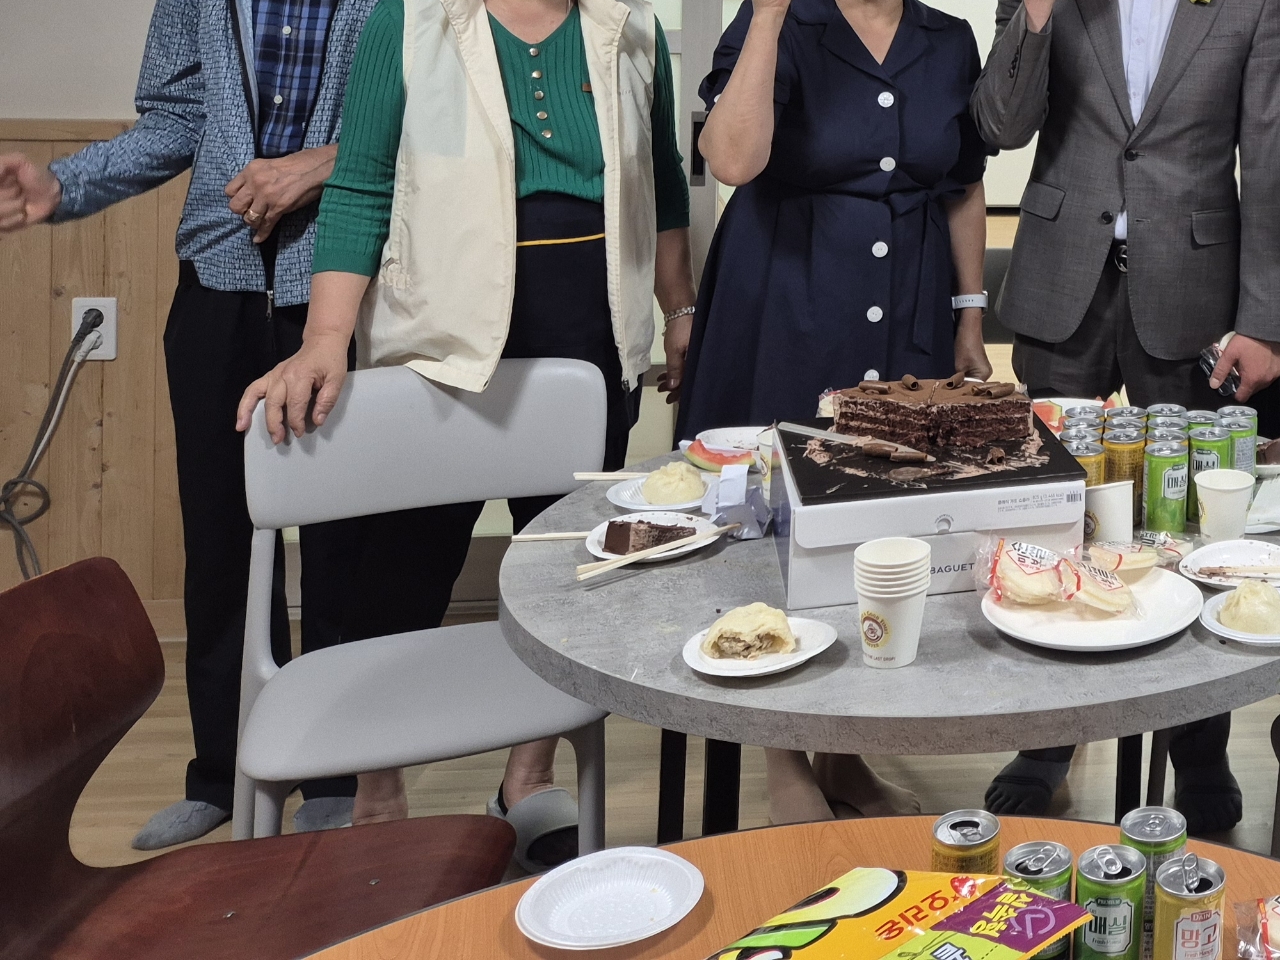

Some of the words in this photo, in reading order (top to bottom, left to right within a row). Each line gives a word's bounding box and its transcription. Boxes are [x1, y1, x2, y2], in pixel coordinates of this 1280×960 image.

[930, 562, 976, 575] BAGUET
[875, 889, 951, 941] 오리온
[1088, 914, 1127, 936] 매실
[1181, 923, 1218, 948] 망고
